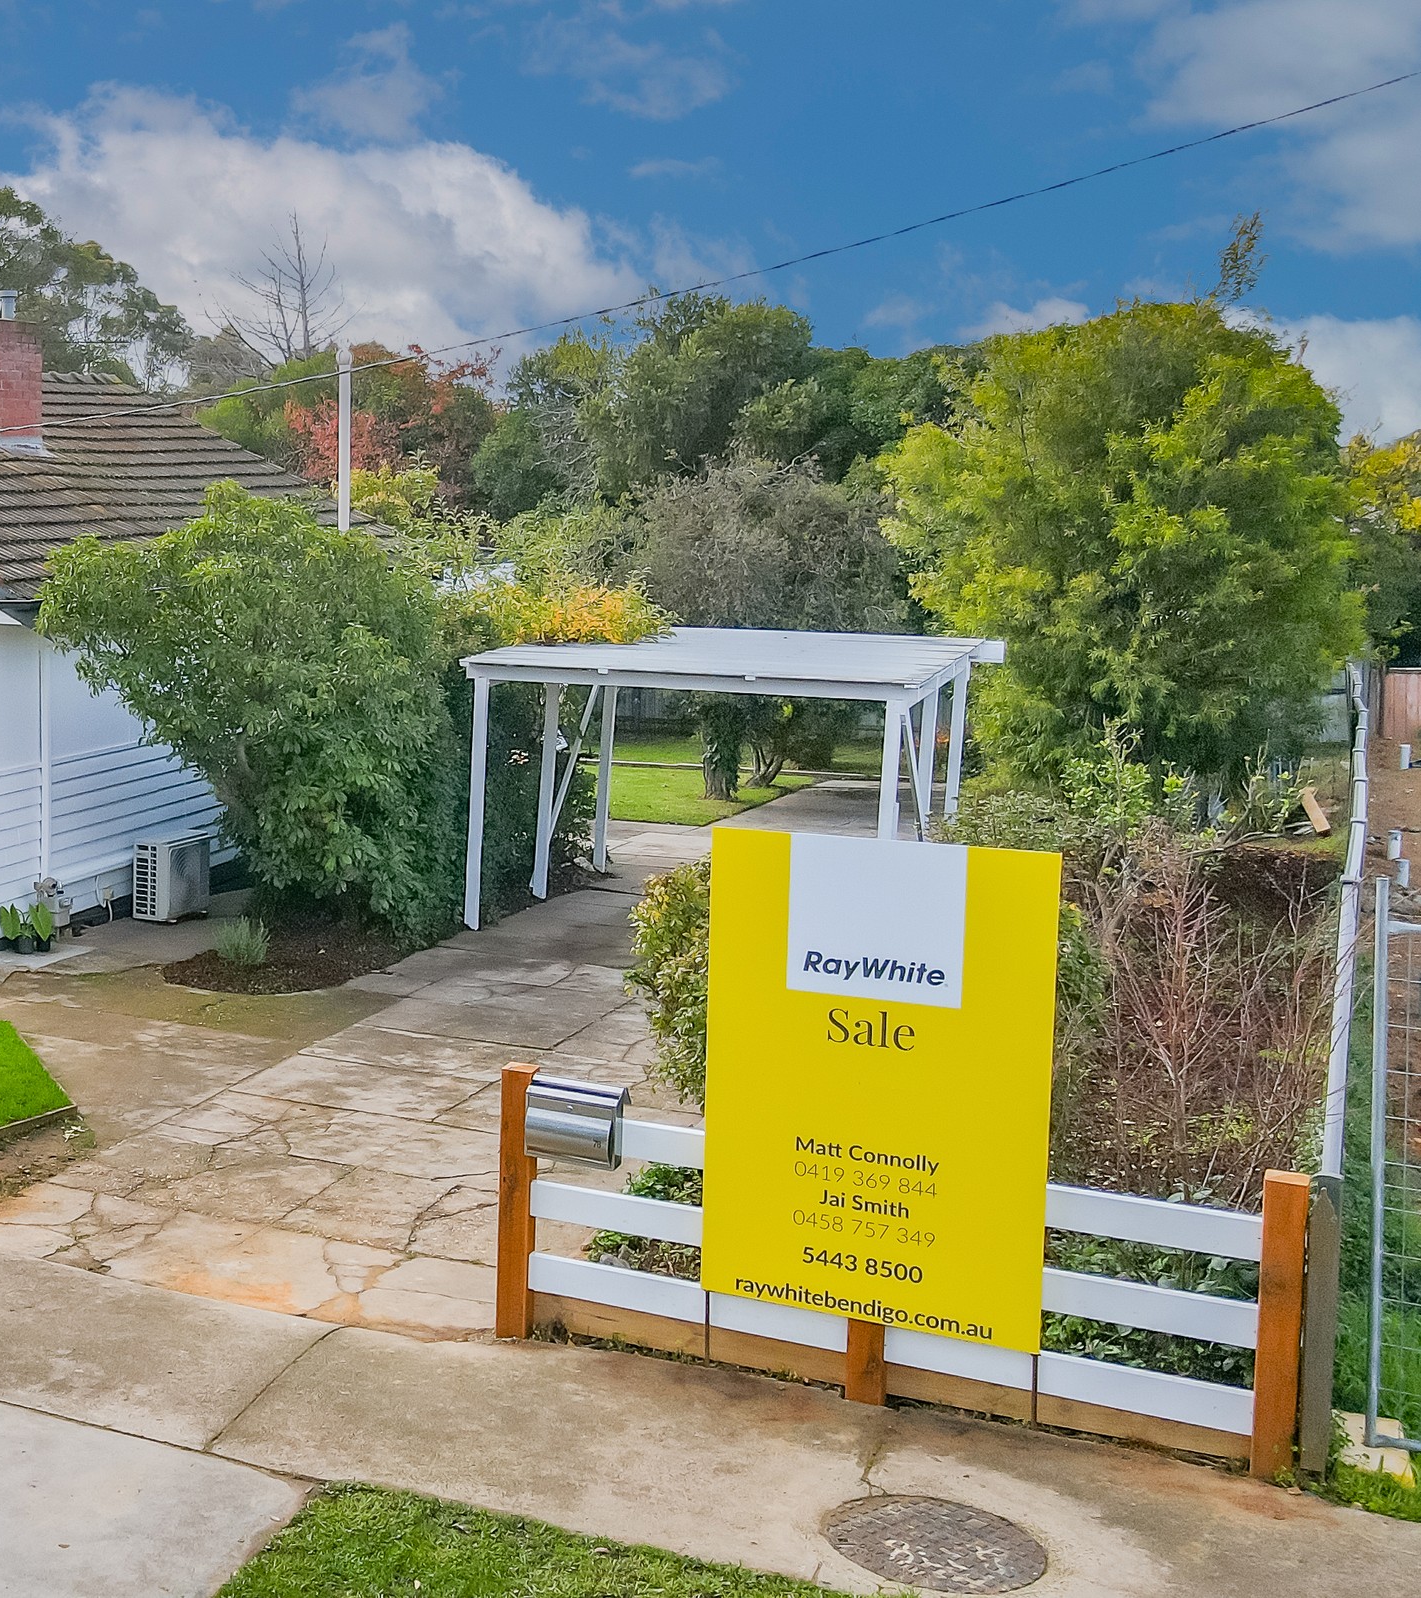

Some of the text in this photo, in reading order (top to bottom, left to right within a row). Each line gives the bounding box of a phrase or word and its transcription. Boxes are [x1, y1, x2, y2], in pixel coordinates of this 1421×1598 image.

[827, 1008, 916, 1052] Sale
[795, 1136, 940, 1177] Matt Connolly
[794, 1161, 938, 1199] 0419 369 844
[819, 1189, 910, 1220] Jai Smith
[792, 1209, 936, 1248] 0458 757 349
[802, 1246, 924, 1285] 5443 8500
[734, 1277, 993, 1341] raywhitebendigo.com.au
